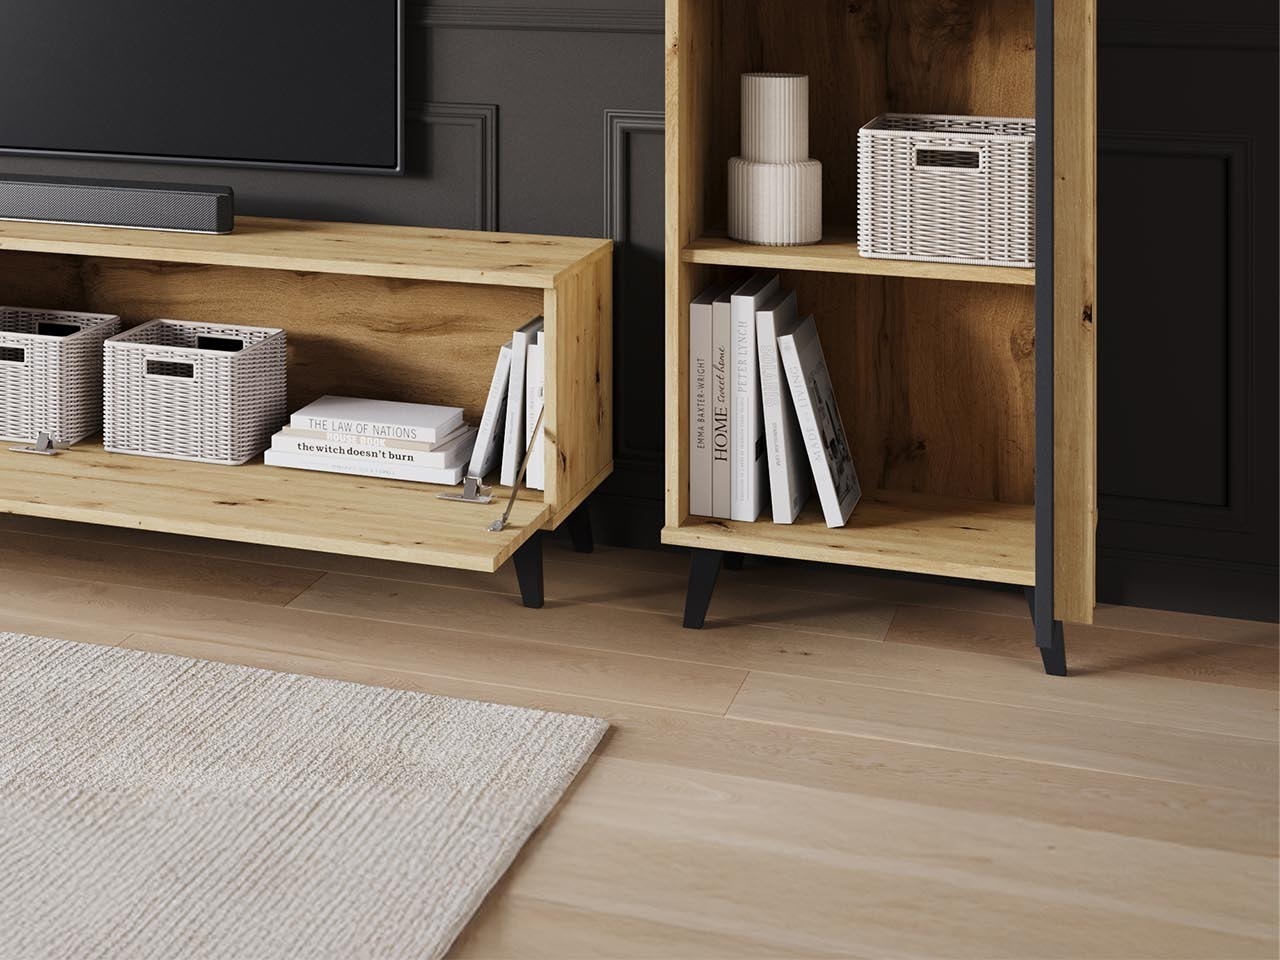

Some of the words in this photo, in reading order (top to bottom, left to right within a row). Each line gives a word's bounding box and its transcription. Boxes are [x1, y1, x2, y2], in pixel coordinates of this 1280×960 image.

[737, 320, 747, 356] LYNCH
[712, 344, 726, 373] home
[697, 357, 705, 423] BAXTER-WRIGHT
[737, 359, 747, 393] PETER
[309, 419, 327, 431] THE
[332, 421, 353, 433] LAW
[356, 423, 368, 434] OF
[373, 425, 417, 439] NATIONS
[697, 426, 705, 449] EMMA
[714, 406, 728, 462] HOME
[298, 443, 315, 452] the
[316, 444, 346, 456] witch
[347, 446, 386, 459] doesn't
[388, 451, 415, 462] burn
